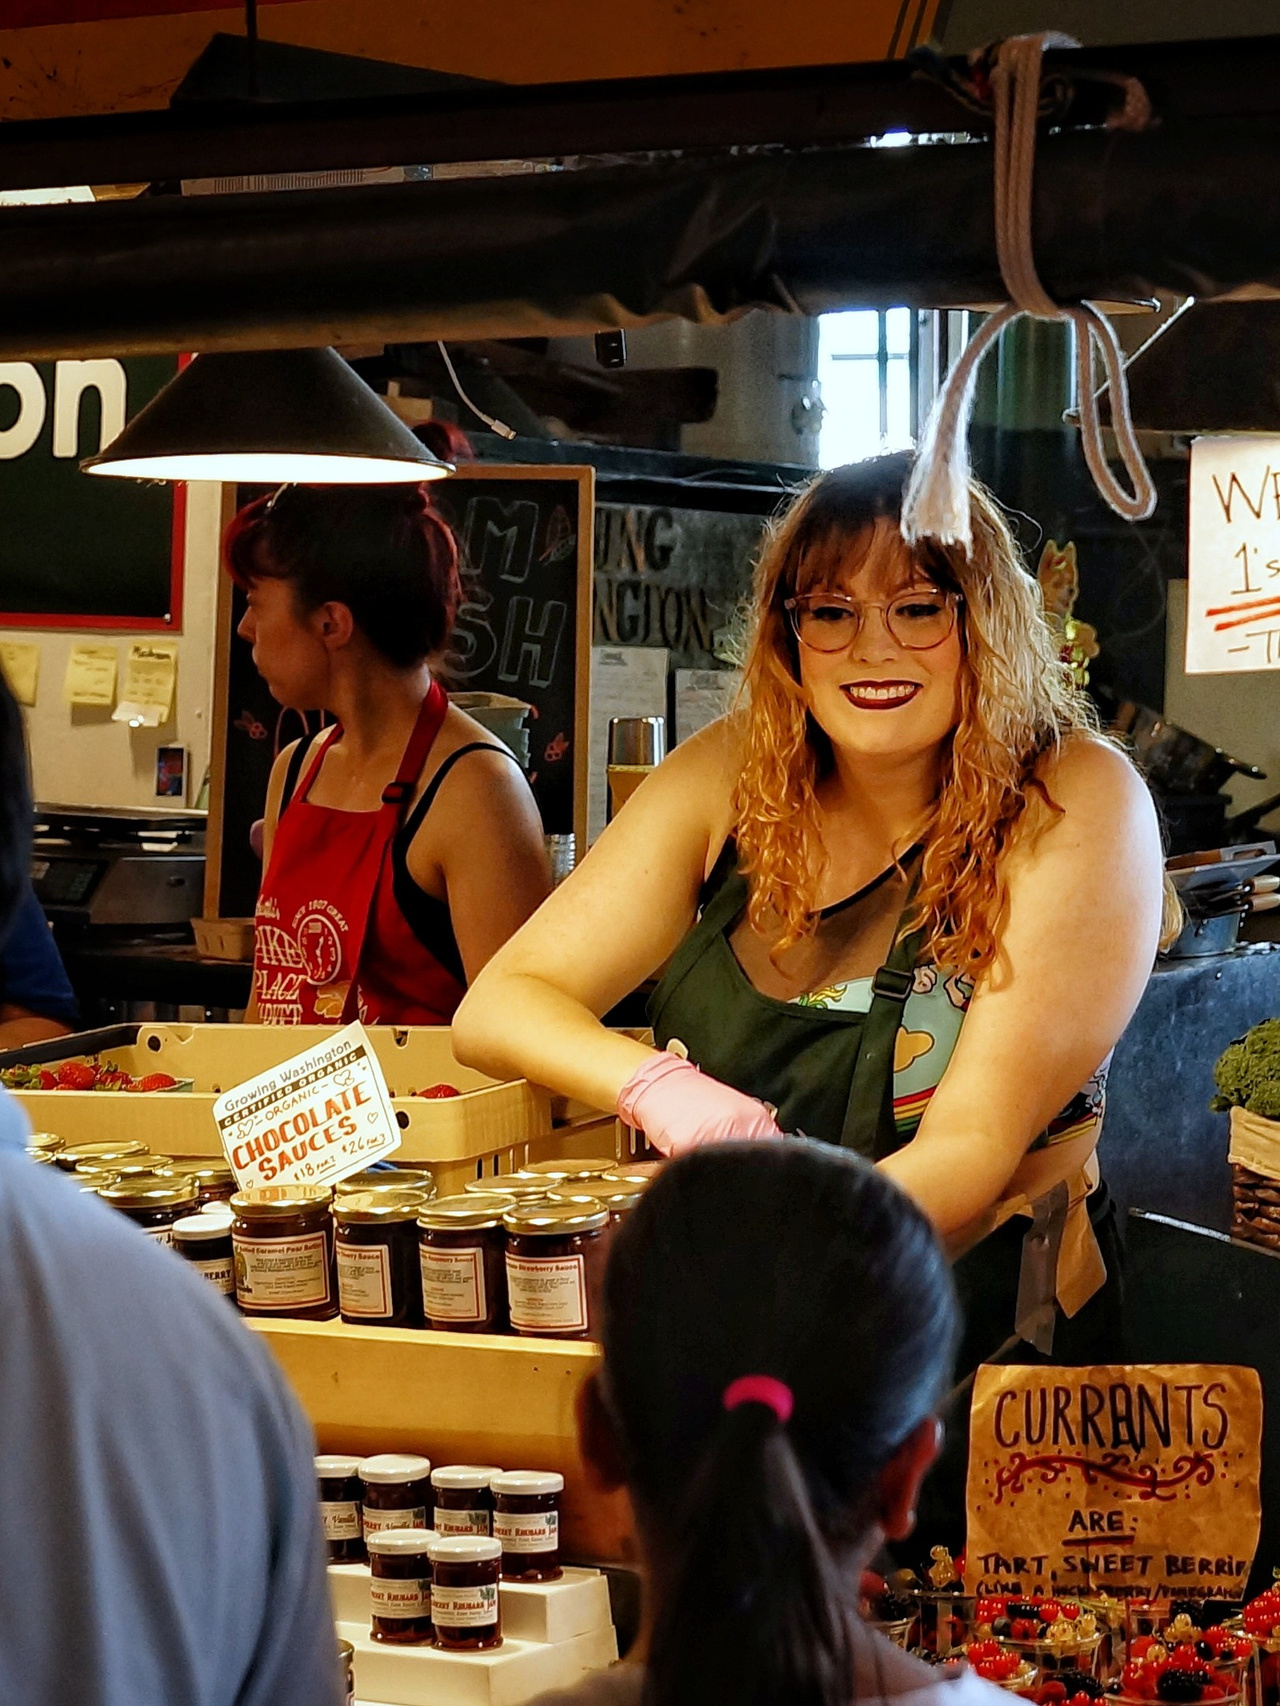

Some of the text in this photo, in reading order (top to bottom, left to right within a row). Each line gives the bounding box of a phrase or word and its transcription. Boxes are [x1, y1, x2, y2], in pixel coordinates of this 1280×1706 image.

[224, 1052, 358, 1126] CERTIFIED ORGANIC
[225, 1041, 352, 1113] Growing Washington
[232, 1081, 372, 1170] CHOCOLATE
[258, 1115, 358, 1181] SAUCES
[994, 1383, 1229, 1450] CURRANTS
[1068, 1509, 1138, 1532] ARE:
[1063, 1553, 1153, 1576] SWEET
